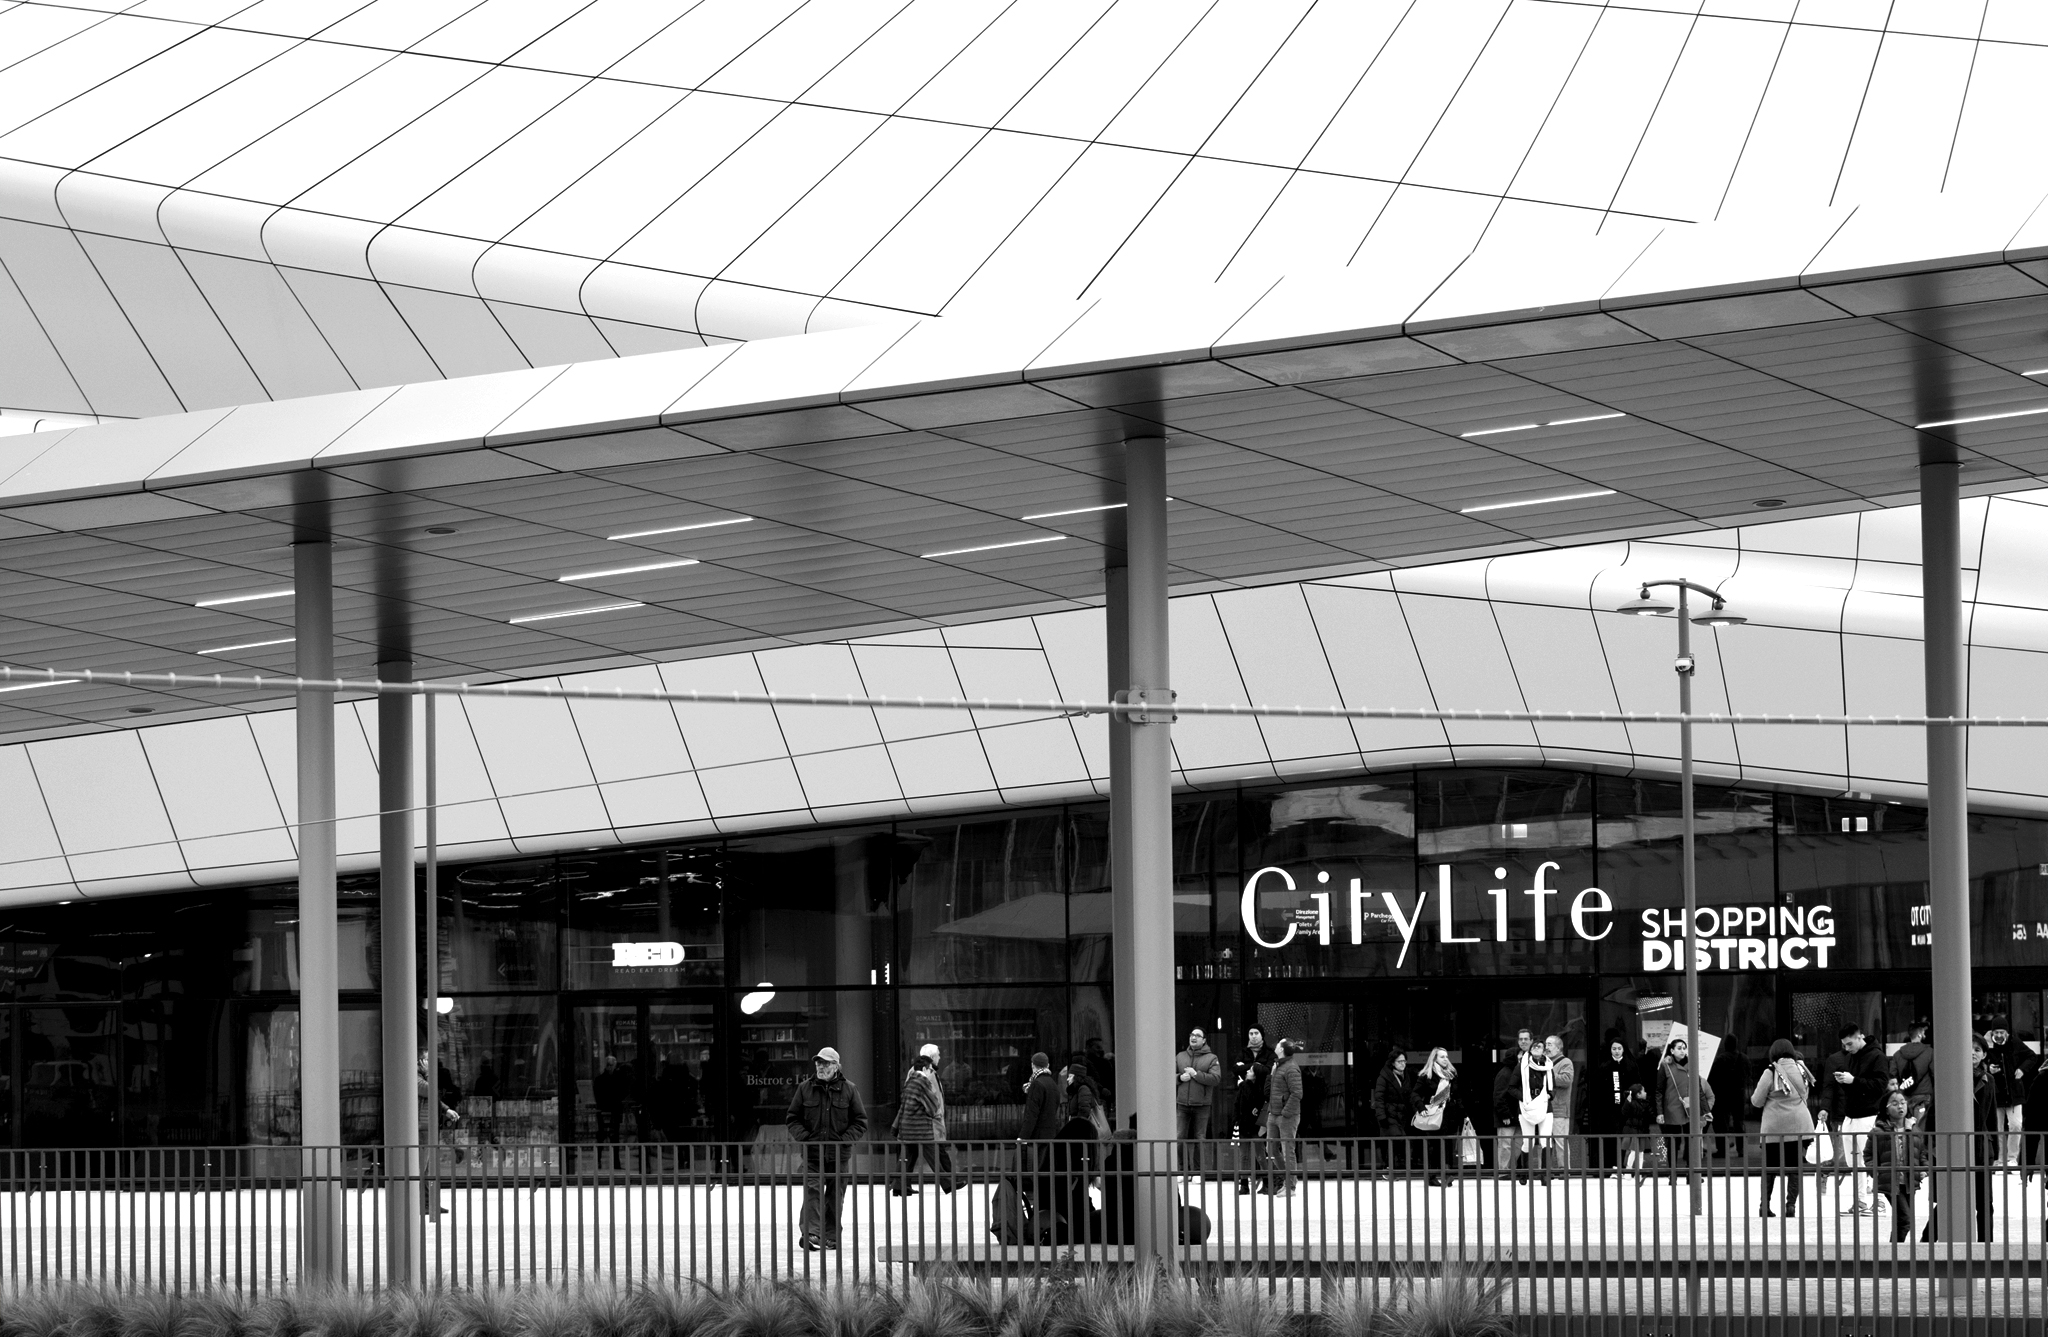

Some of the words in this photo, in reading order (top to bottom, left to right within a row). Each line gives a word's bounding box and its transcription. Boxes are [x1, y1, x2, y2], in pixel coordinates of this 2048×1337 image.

[1241, 861, 1614, 969] CityLife
[1641, 905, 1835, 938] SHOPPING
[1643, 937, 1836, 971] DISTRICT
[746, 1074, 784, 1086] Bistrot
[786, 1077, 793, 1085] e
